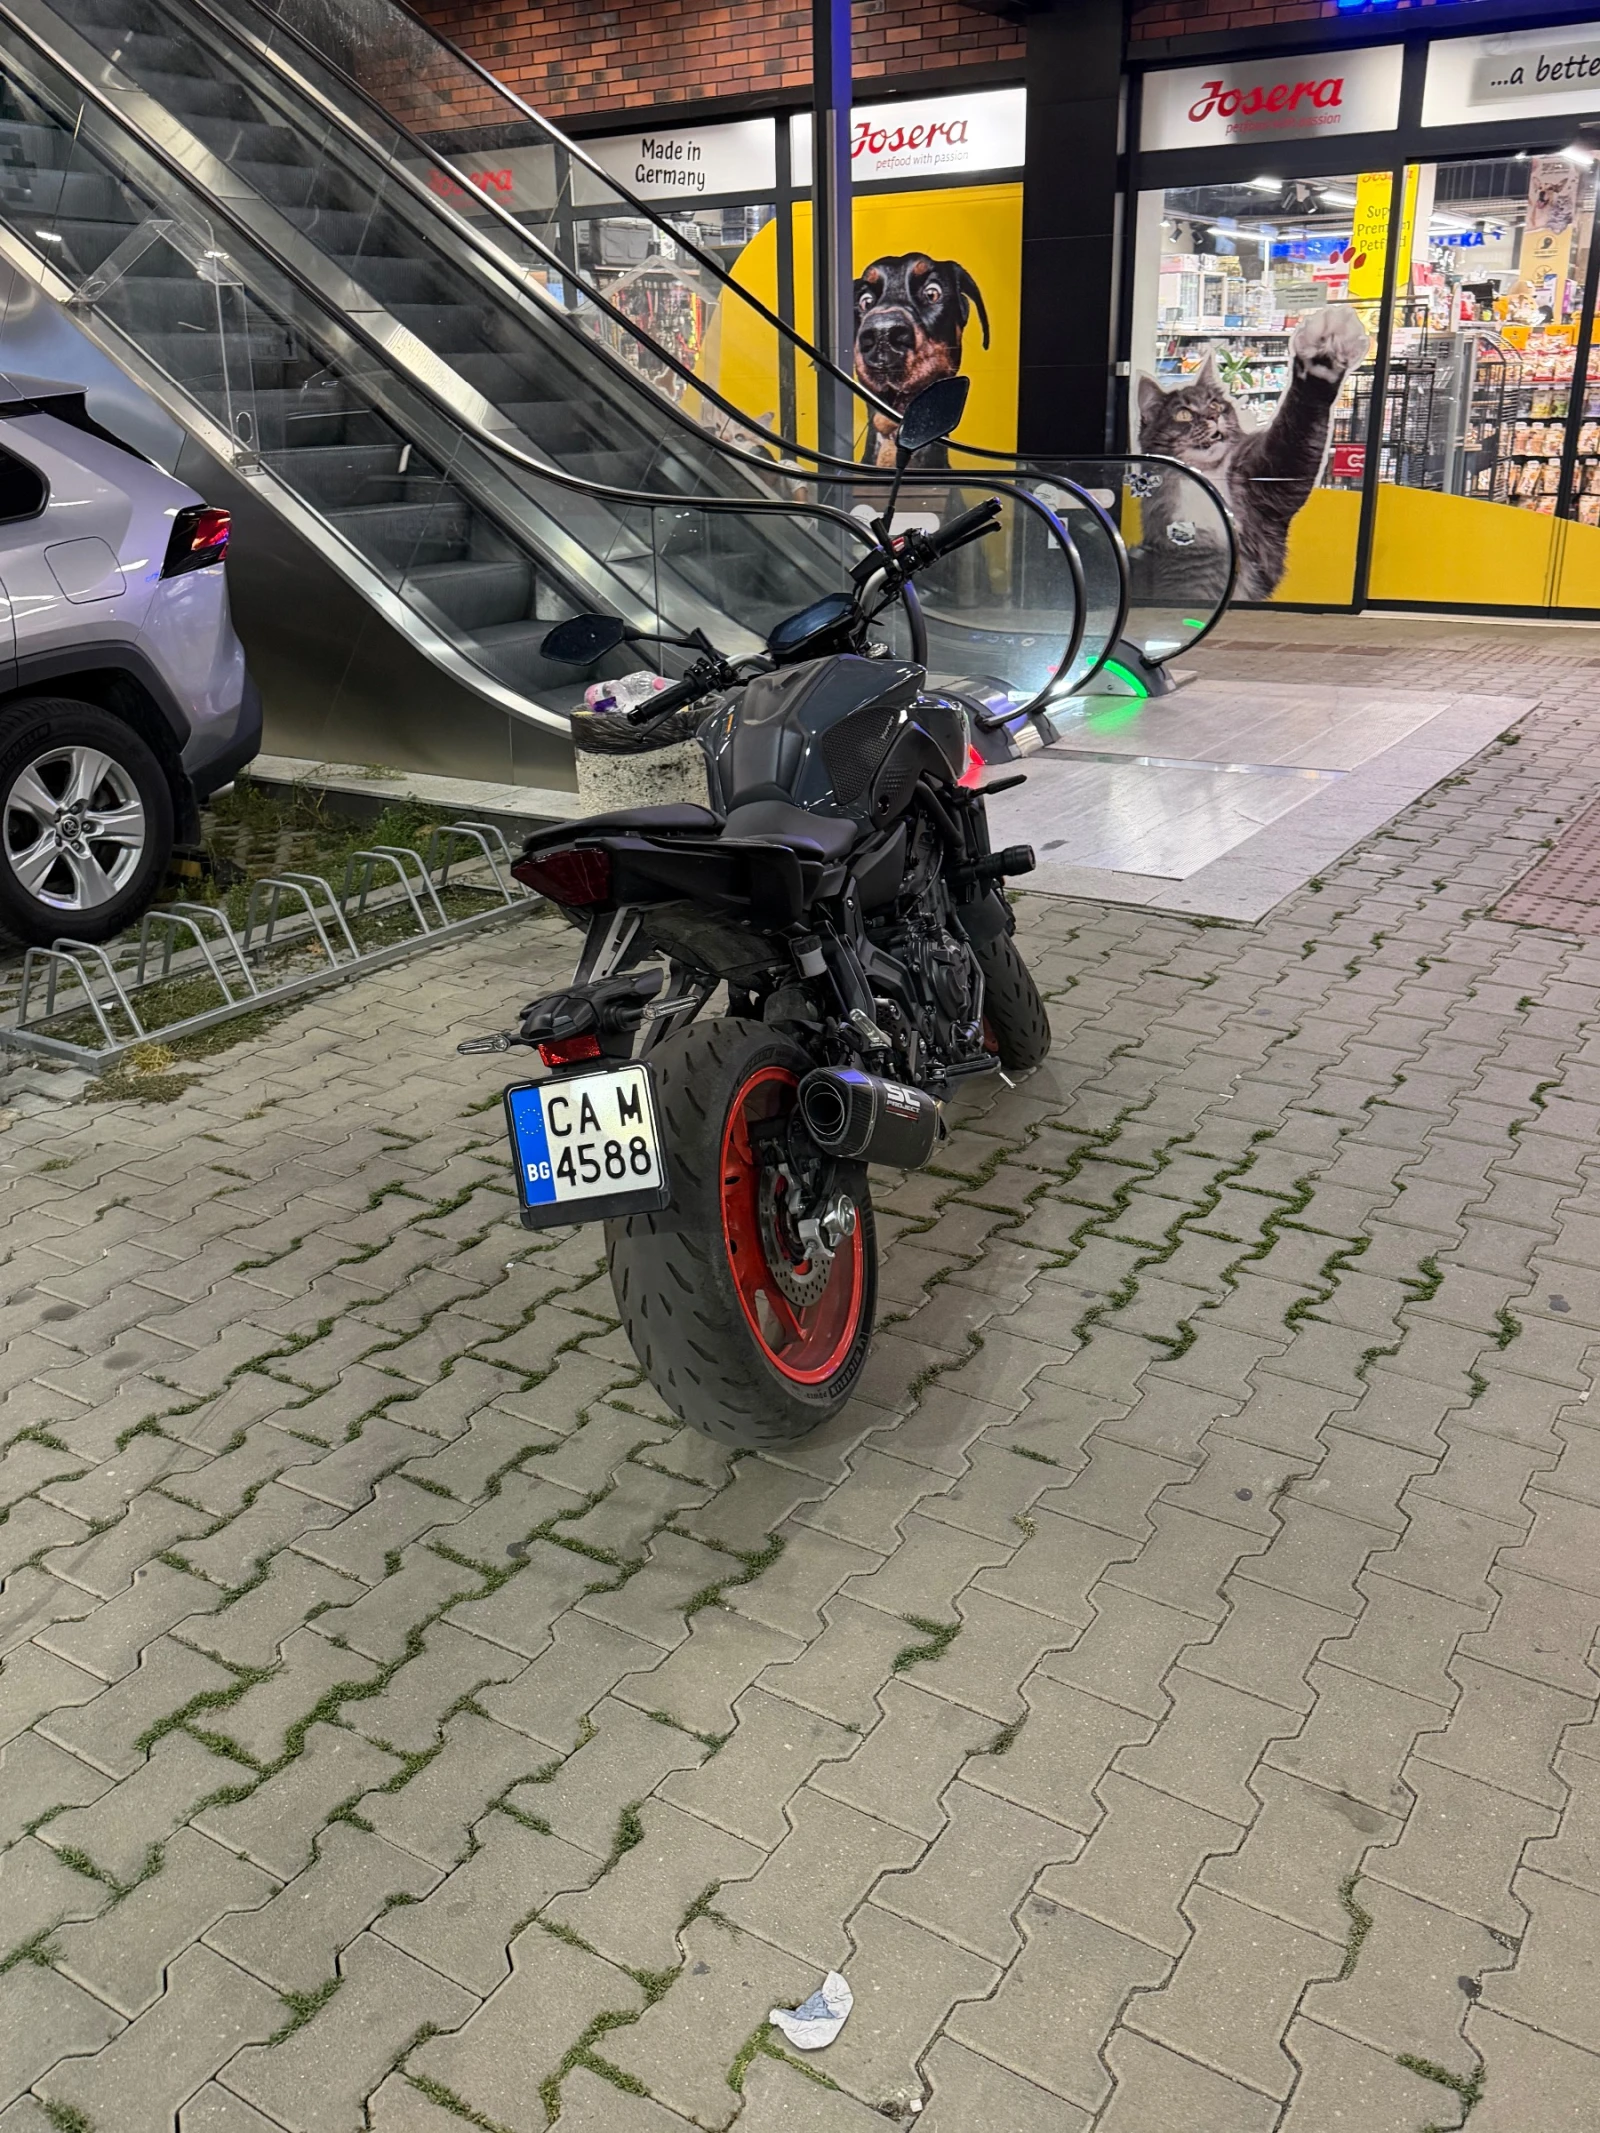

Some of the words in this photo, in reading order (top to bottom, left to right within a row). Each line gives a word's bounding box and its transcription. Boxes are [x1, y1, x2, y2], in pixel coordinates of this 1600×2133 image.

[1188, 78, 1345, 122] Josera
[642, 138, 683, 160] Made
[688, 141, 701, 161] in
[851, 120, 968, 159] Josera
[876, 155, 911, 171] petfood
[913, 153, 933, 165] with
[934, 150, 969, 166] passion
[635, 164, 705, 191] Germany
[1367, 205, 1391, 219] Sup
[1357, 221, 1411, 236] Premm
[1360, 236, 1406, 252] Petfd
[883, 1082, 920, 1108] SC
[547, 1092, 602, 1137] CA
[616, 1083, 643, 1127] M
[527, 1161, 551, 1182] BG
[557, 1136, 652, 1187] 4588
